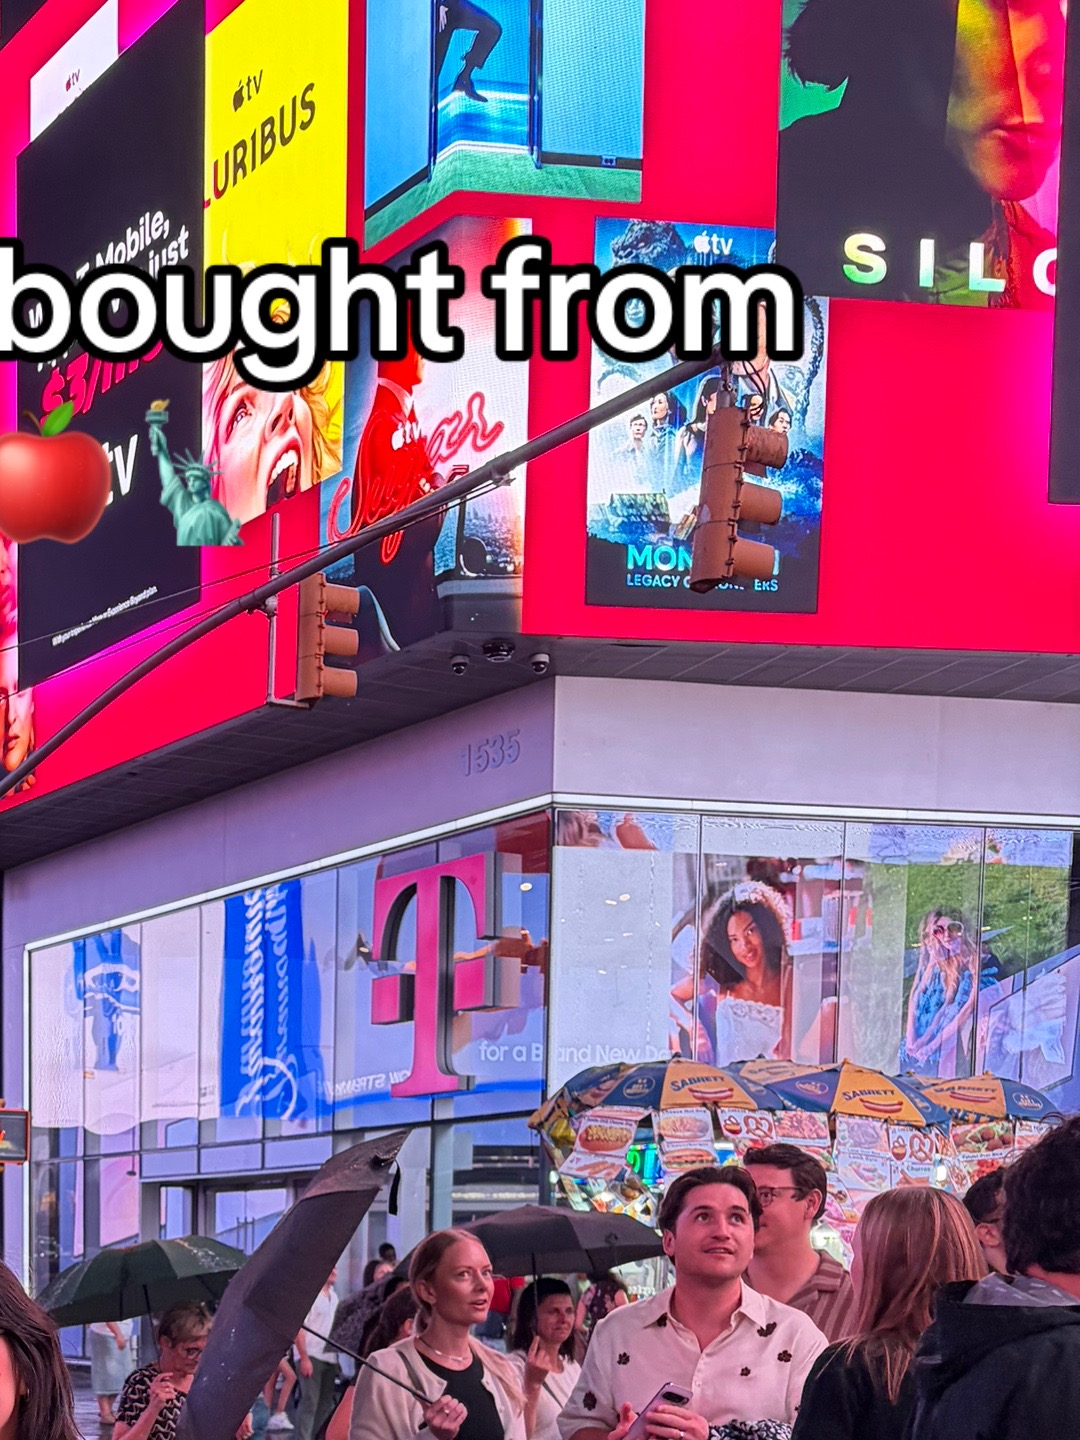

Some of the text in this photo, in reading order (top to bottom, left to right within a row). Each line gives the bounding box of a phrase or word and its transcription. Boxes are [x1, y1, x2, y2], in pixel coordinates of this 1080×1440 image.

[246, 69, 263, 101] tv
[204, 83, 316, 208] URIBUS
[711, 233, 733, 255] tv
[626, 574, 680, 588] LEGACY
[461, 728, 521, 777] 1535
[479, 1042, 509, 1062] for
[513, 1046, 527, 1062] a
[596, 1044, 641, 1062] New
[670, 1075, 725, 1090] SABRETT
[842, 1088, 895, 1101] SABRETT
